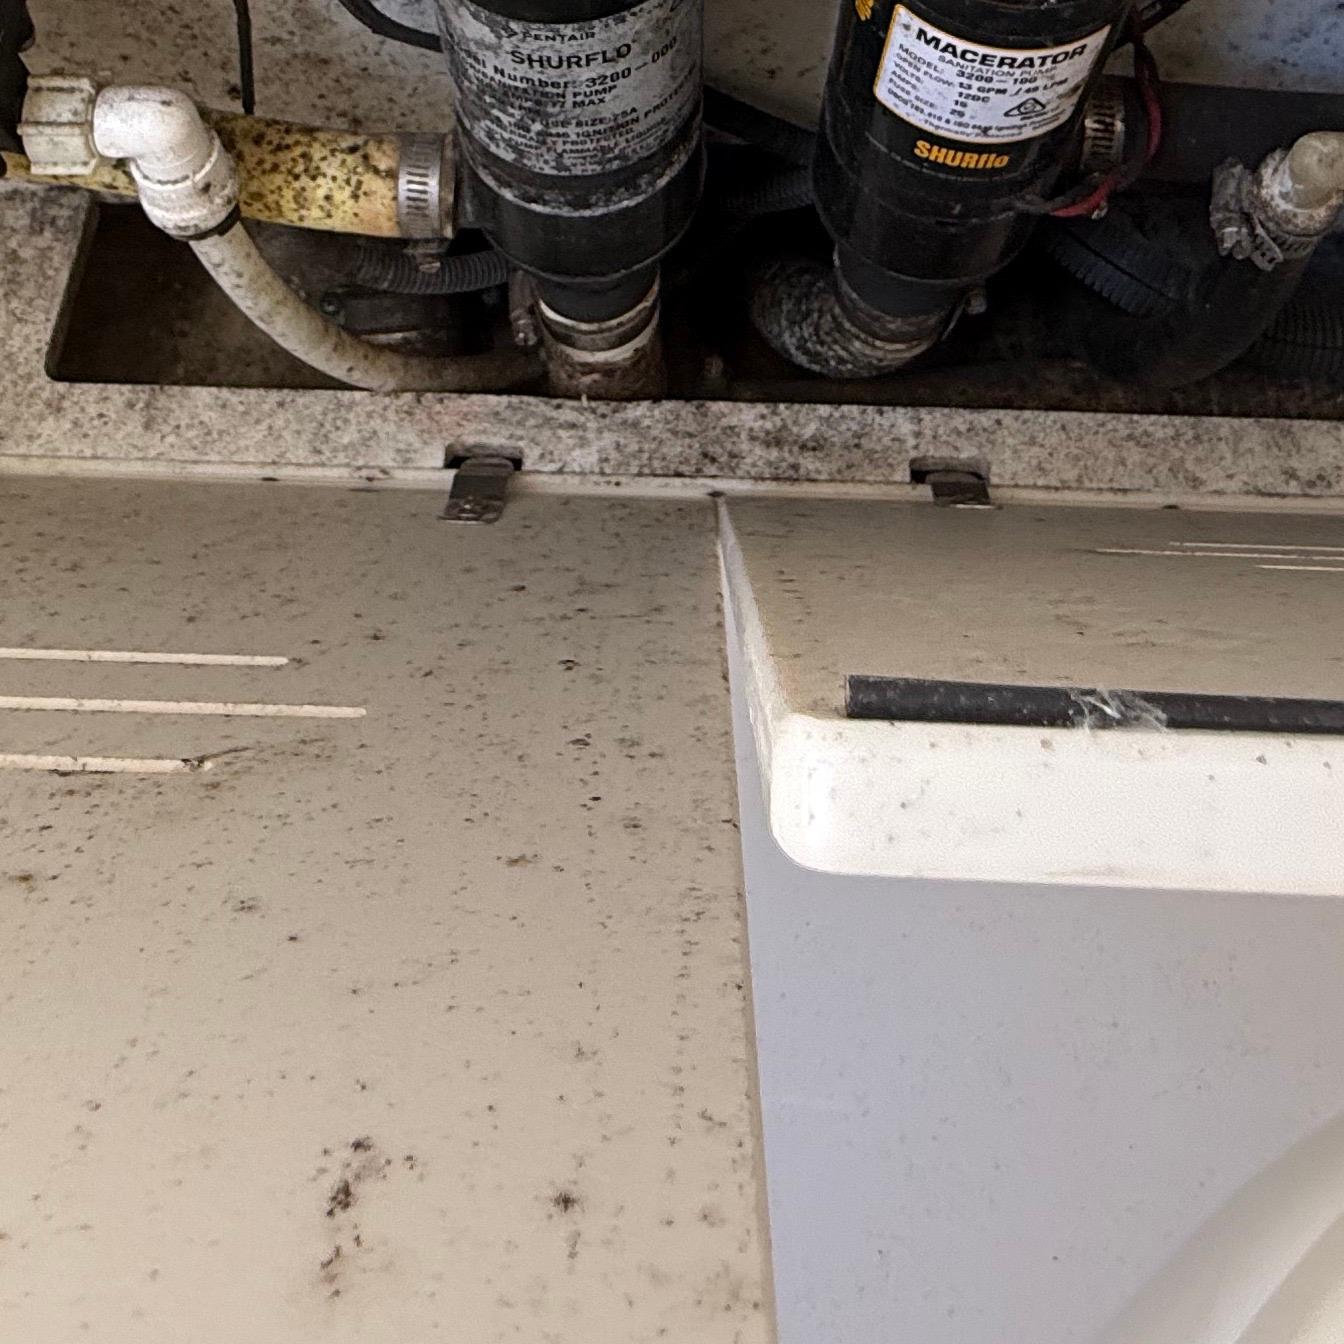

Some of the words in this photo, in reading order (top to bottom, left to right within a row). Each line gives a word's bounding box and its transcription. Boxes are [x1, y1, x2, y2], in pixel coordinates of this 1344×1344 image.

[915, 28, 1087, 68] MACERATOR
[510, 43, 632, 69] SHURFLO
[572, 85, 617, 98] PUMP
[977, 84, 1007, 95] GPM
[572, 96, 606, 108] MAX
